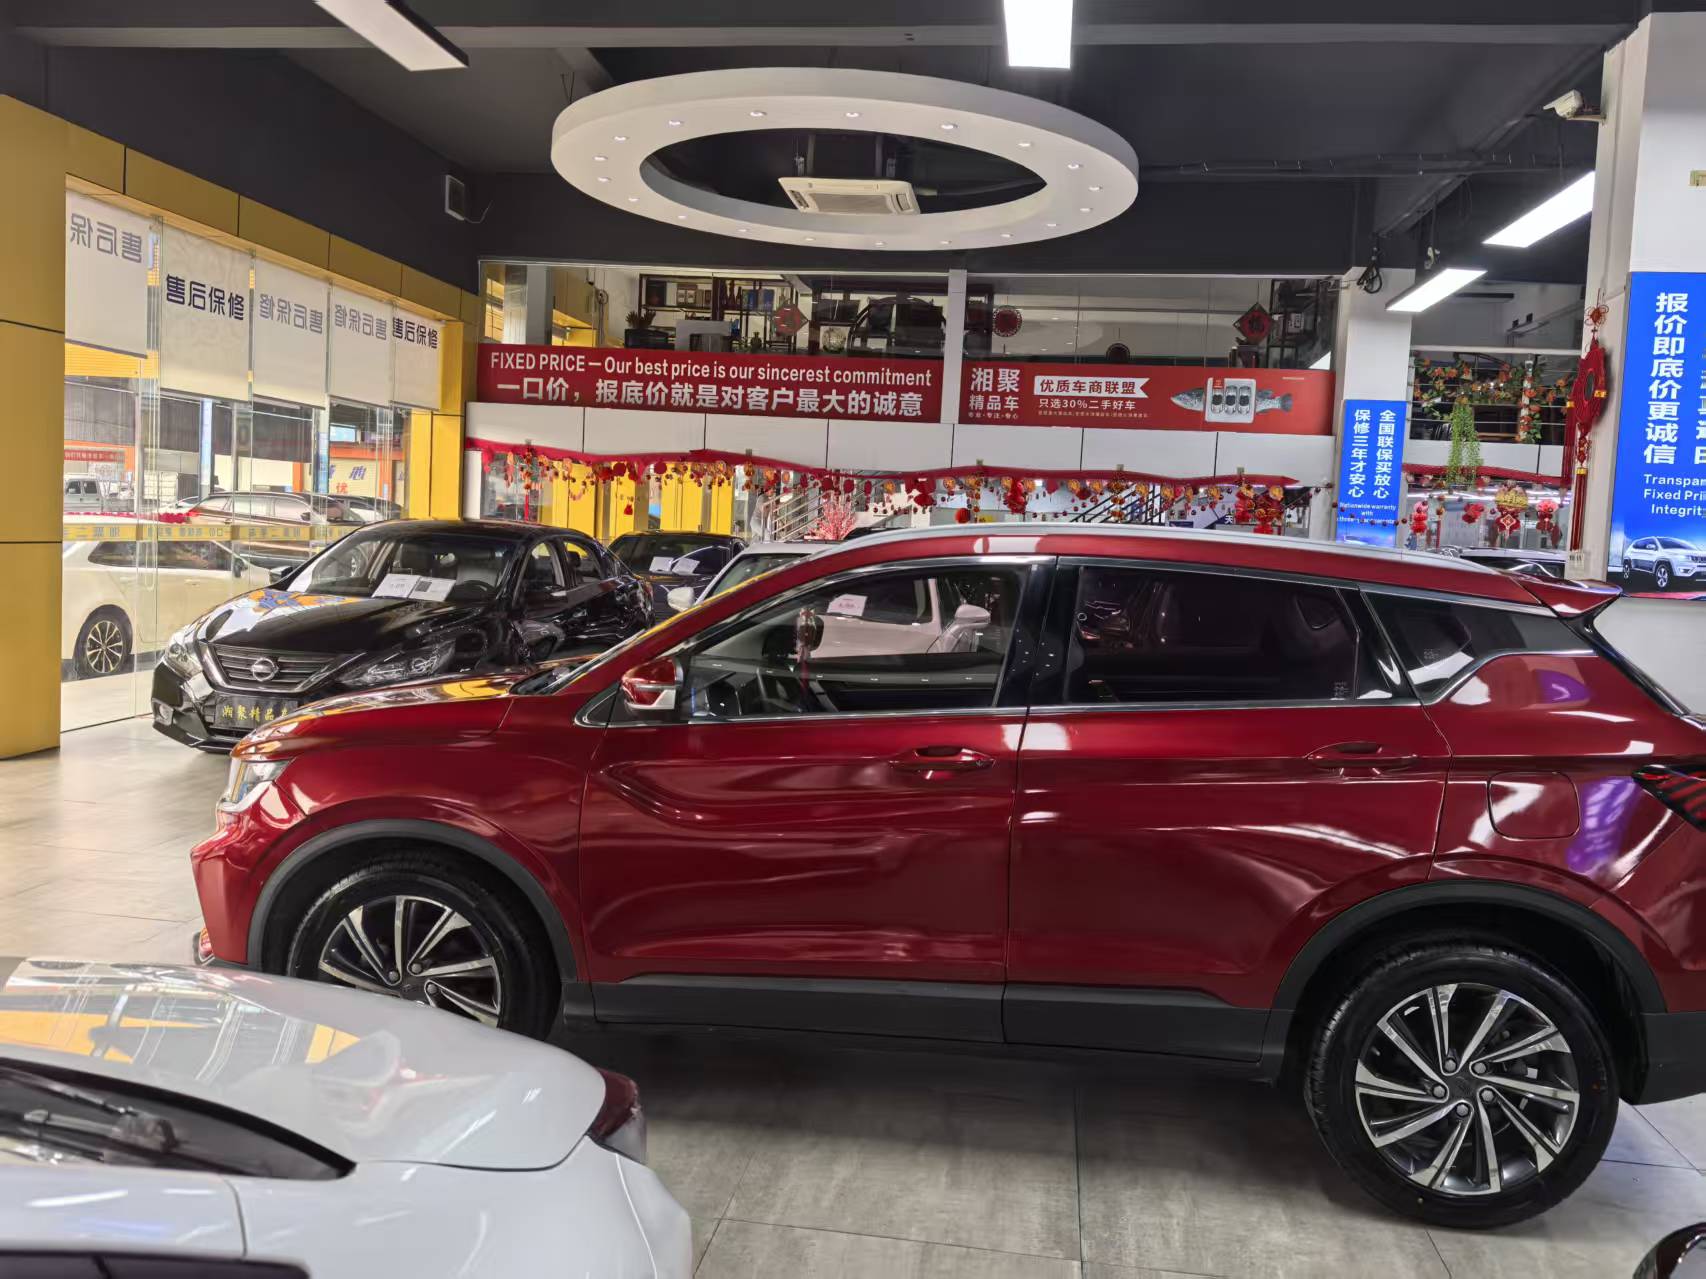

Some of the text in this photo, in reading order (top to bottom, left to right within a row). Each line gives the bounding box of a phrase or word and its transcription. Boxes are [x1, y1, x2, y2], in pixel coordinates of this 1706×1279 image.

[166, 274, 245, 321] 售后保修
[392, 316, 438, 349] 售后保修
[491, 352, 536, 369] FIXED
[635, 357, 669, 376] best
[672, 360, 710, 380] price
[713, 361, 726, 379] is
[729, 364, 755, 380] our
[757, 363, 830, 383] sincerest
[834, 367, 932, 386] commitment
[970, 367, 1021, 392] 湘聚
[1643, 291, 1688, 464] 报价即底价更诚信
[969, 394, 1020, 411] 精品车
[1039, 378, 1137, 395] 优质车商联盟
[1039, 398, 1136, 410] 只选30%二手好车
[1348, 409, 1372, 498] 保修三年才安心
[1373, 409, 1397, 499] 全国联保买放心
[1643, 488, 1681, 500] Fixed
